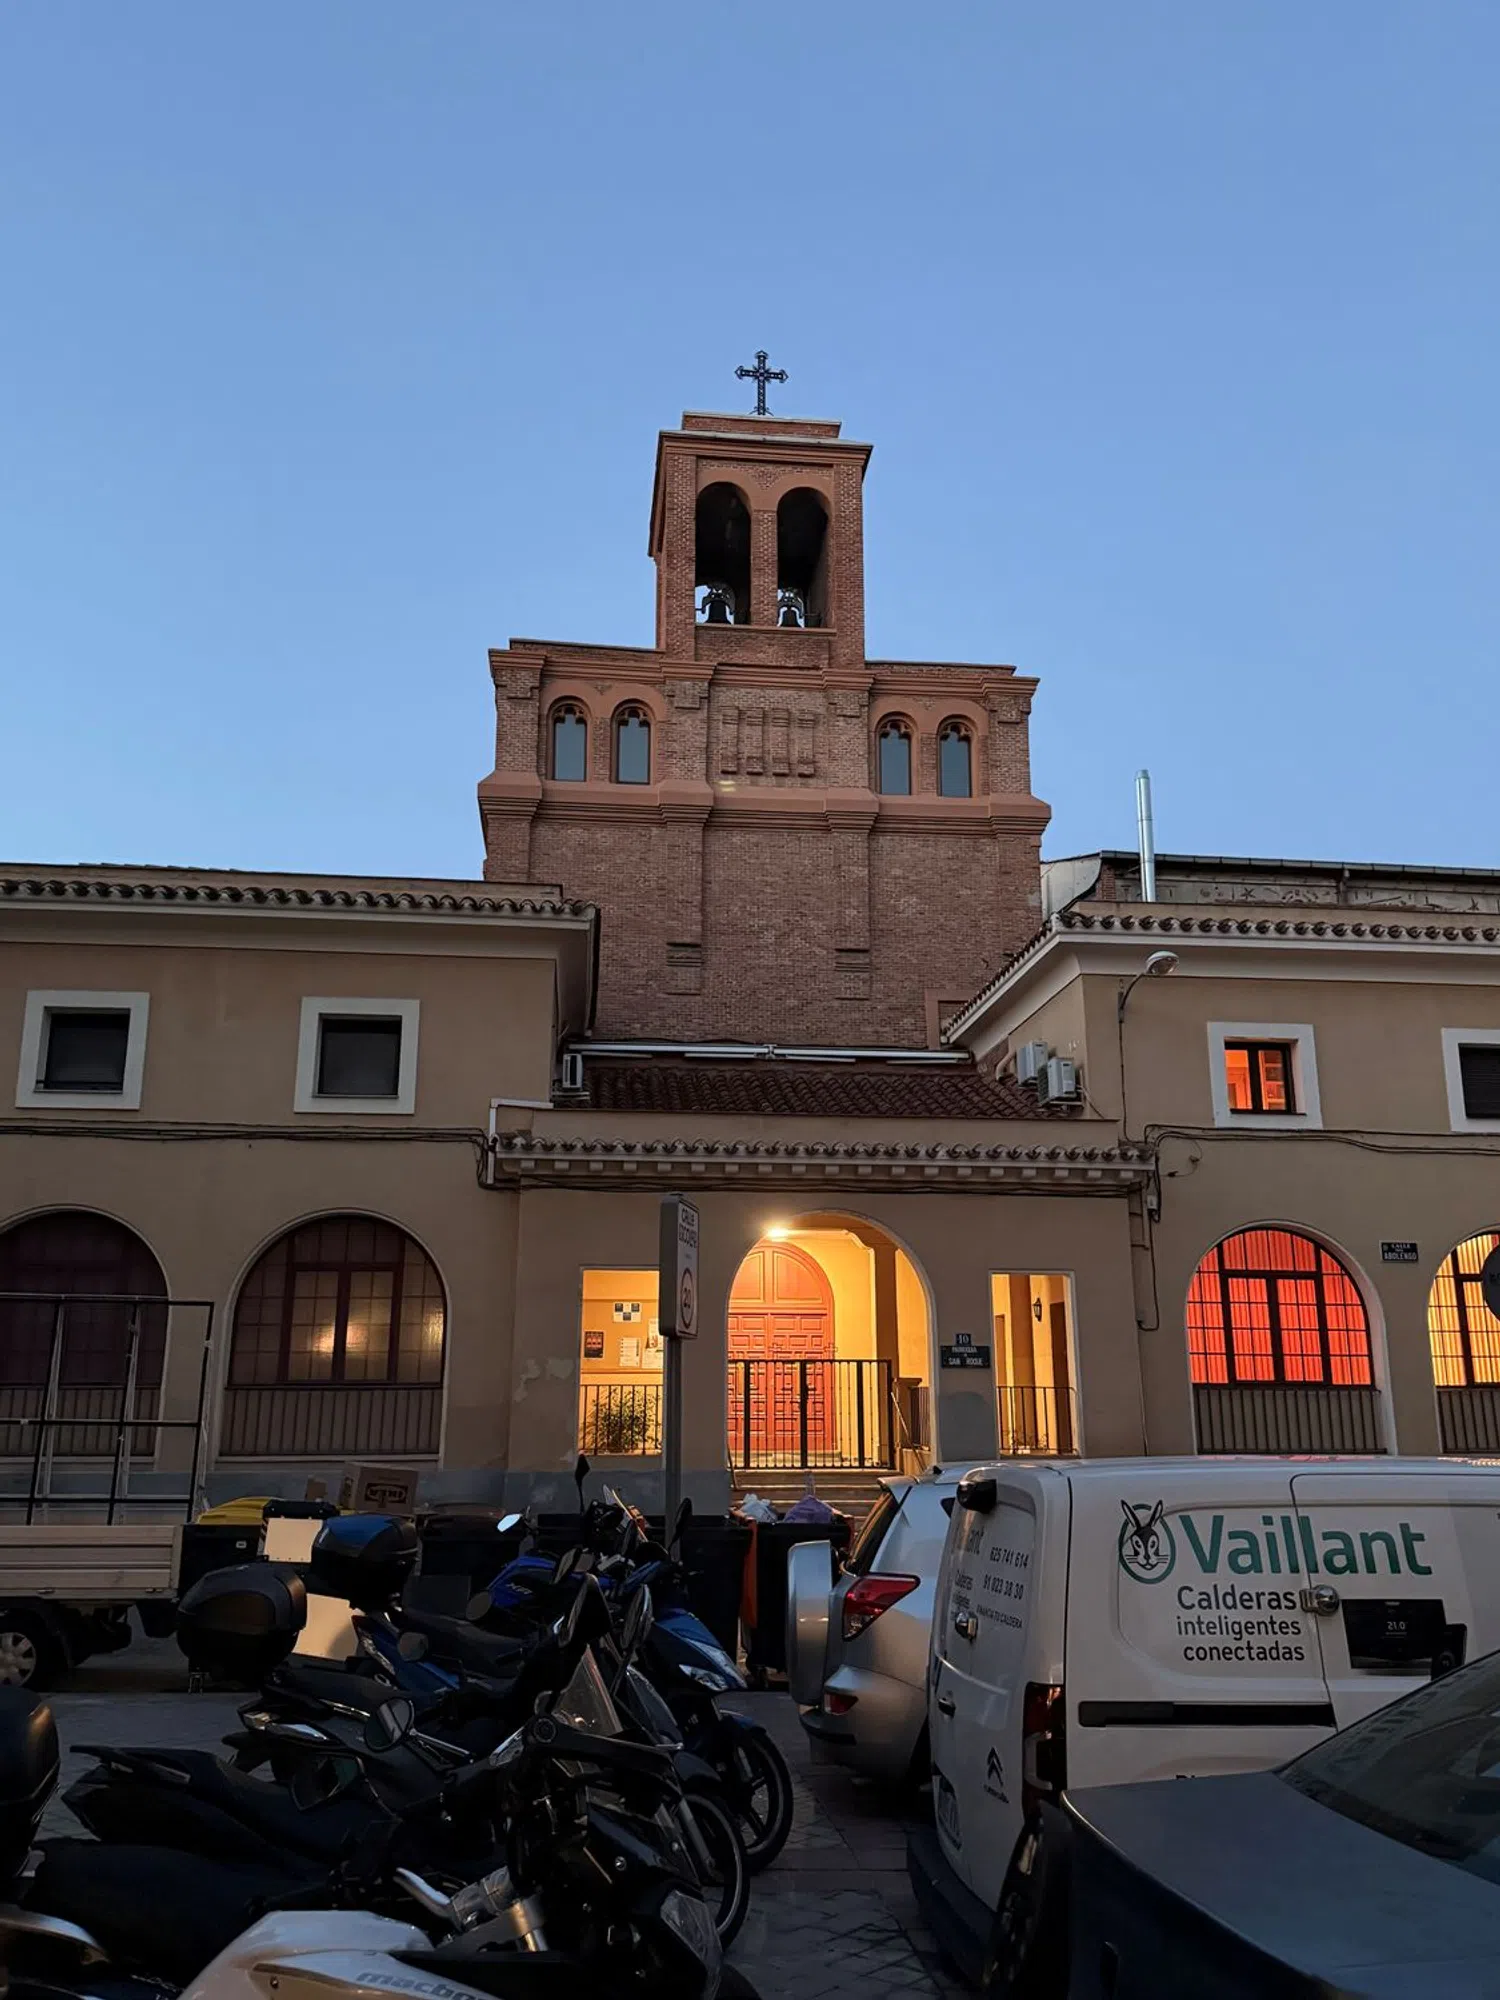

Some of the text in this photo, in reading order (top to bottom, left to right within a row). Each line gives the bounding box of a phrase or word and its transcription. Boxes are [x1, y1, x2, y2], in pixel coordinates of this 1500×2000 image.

[1178, 1514, 1433, 1576] Vaillant
[1177, 1584, 1297, 1611] Calderas
[1177, 1616, 1301, 1641] inteligentes
[1183, 1640, 1306, 1662] conectadas
[356, 1972, 488, 2000] macbo
